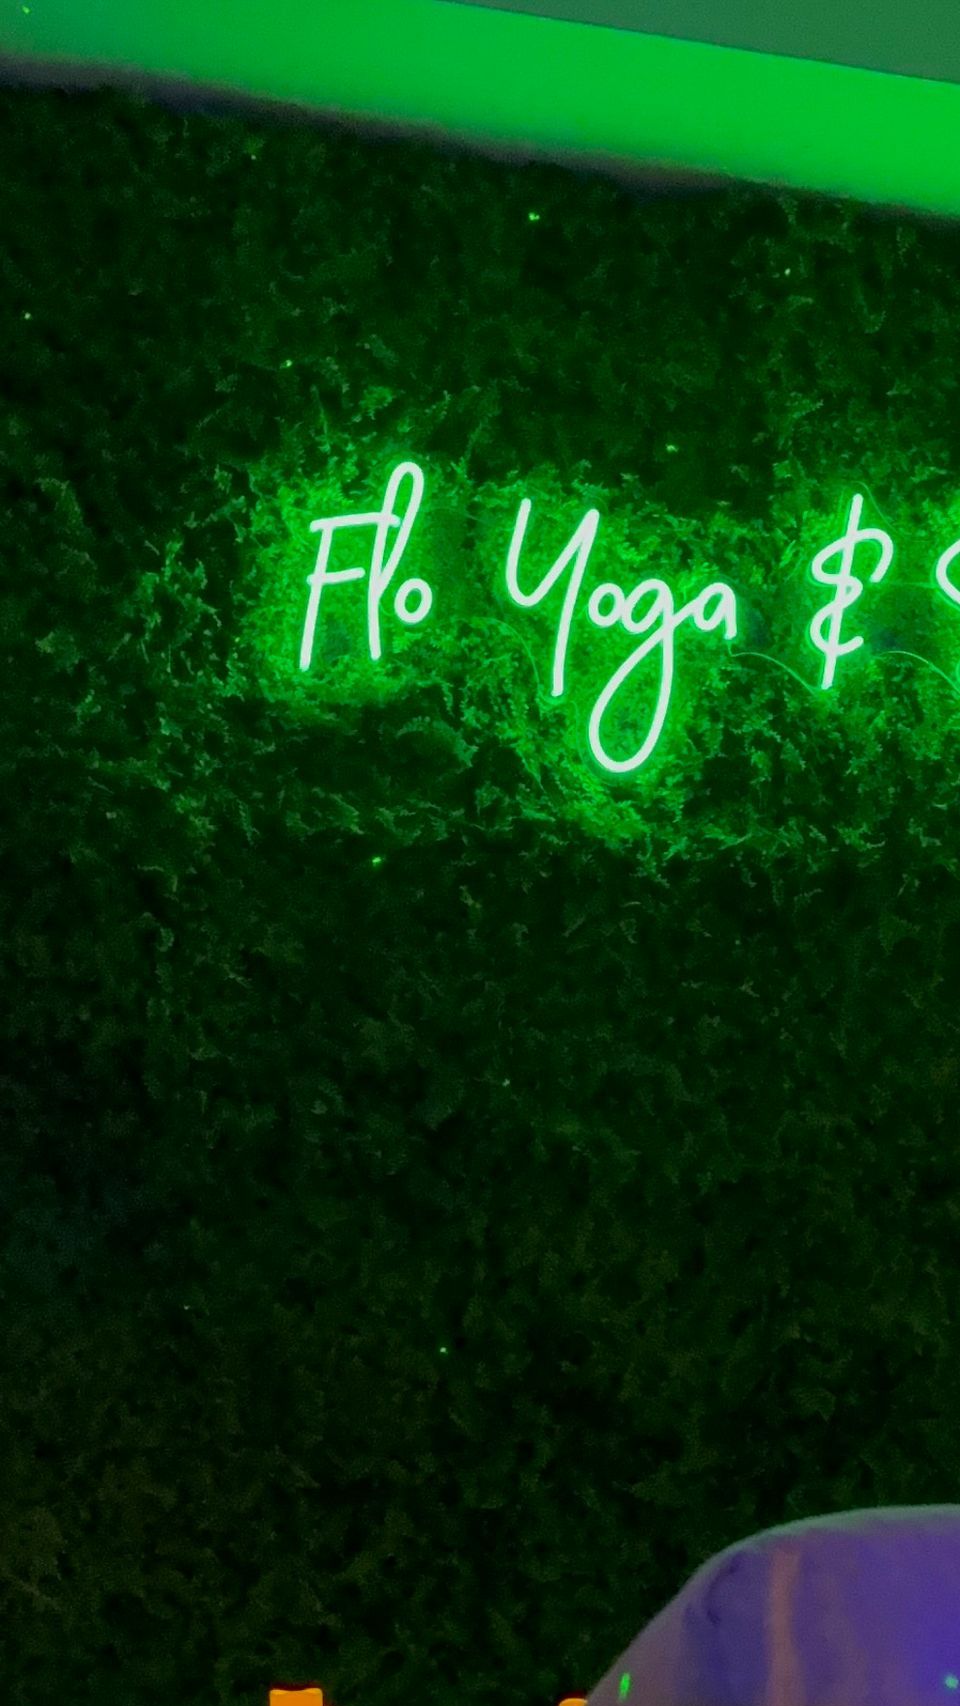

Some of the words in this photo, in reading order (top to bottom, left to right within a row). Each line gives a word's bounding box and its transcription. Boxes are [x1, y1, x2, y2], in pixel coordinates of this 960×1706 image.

[299, 461, 433, 670] Flo
[505, 498, 737, 773] Yoga
[809, 493, 894, 690] &
